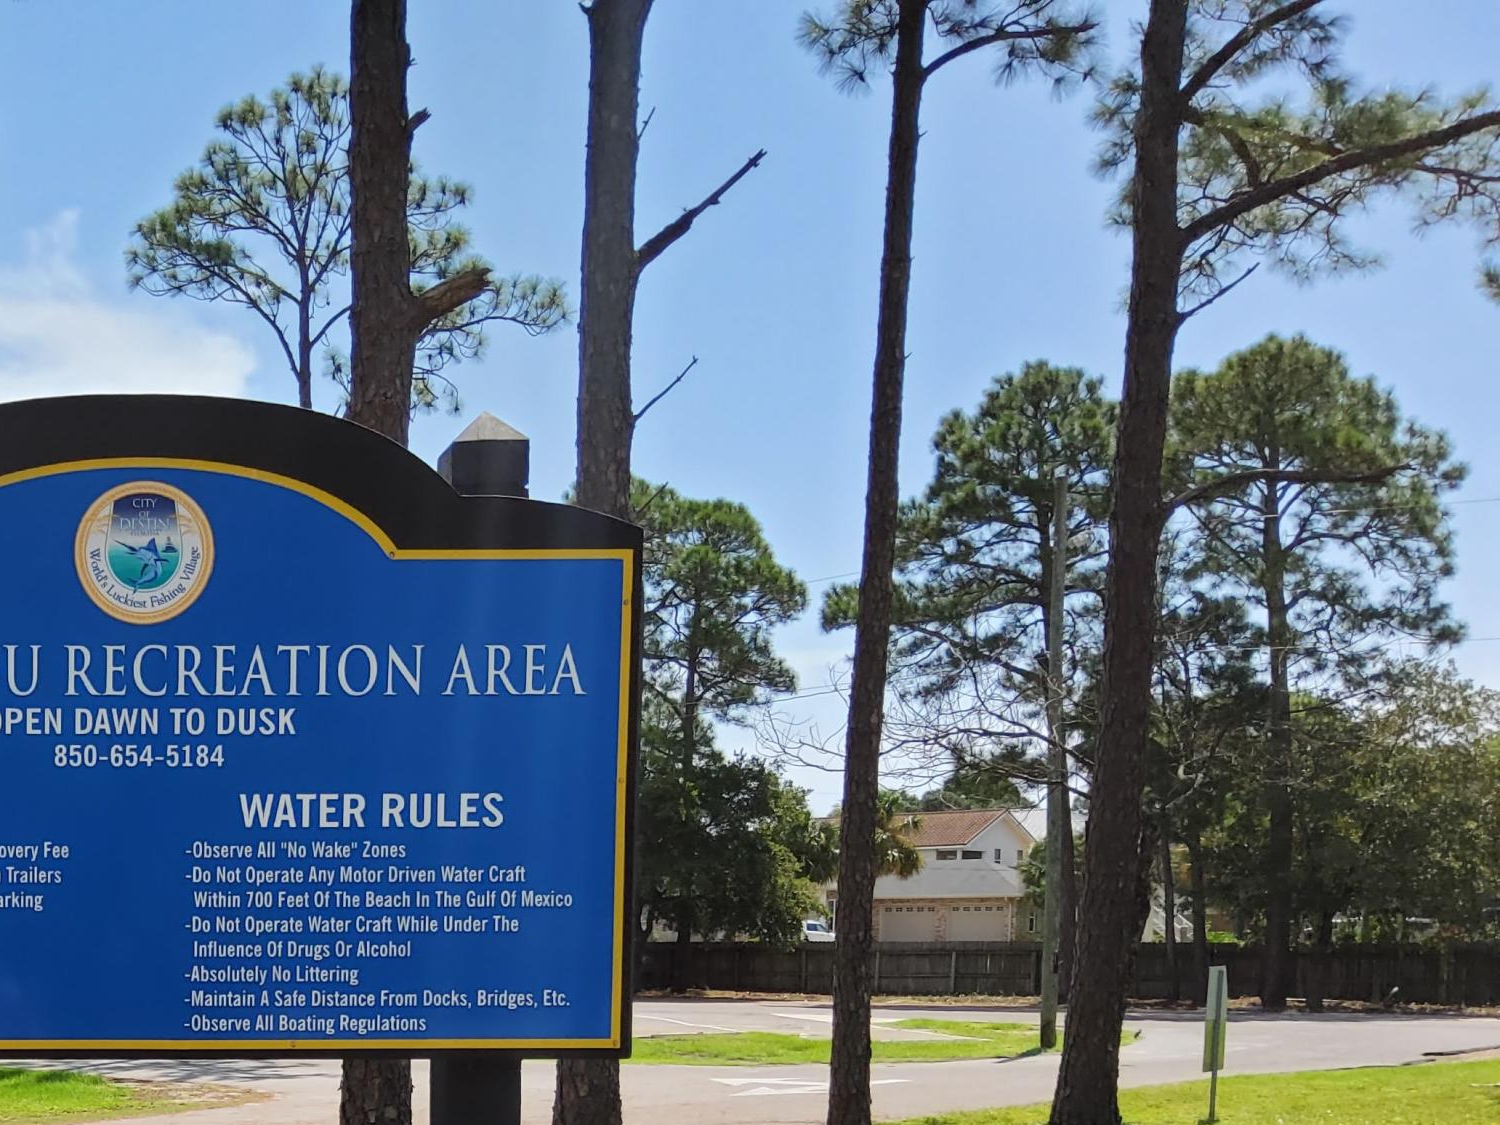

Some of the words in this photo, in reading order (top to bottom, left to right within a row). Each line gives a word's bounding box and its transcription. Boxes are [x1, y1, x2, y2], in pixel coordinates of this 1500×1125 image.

[132, 498, 158, 509] CITY
[119, 517, 170, 530] DESTIN
[89, 547, 108, 588] World's
[106, 584, 147, 608] Luckiest
[150, 583, 187, 608] Fishing
[180, 546, 201, 580] Village
[64, 643, 424, 697] RECREATION
[442, 643, 587, 697] AREA
[75, 708, 158, 734] DAWN
[170, 708, 205, 735] TO
[217, 708, 295, 735] DUSK
[54, 744, 224, 767] 850-654-5184
[240, 793, 365, 828] WATER
[382, 793, 503, 828] RULES
[44, 841, 69, 858] Fee
[186, 841, 252, 858] -Observe
[257, 841, 275, 858] All
[281, 841, 306, 858] "No
[312, 841, 357, 858] Wake"
[362, 841, 406, 858] Zones
[6, 866, 61, 883] Trailers
[185, 866, 211, 883] -Do
[217, 866, 241, 883] Not
[246, 866, 303, 886] Operate
[308, 866, 335, 886] Any
[340, 866, 384, 883] Motor
[388, 866, 435, 882] Driven
[441, 866, 484, 882] Water
[489, 865, 525, 882] Craft
[194, 891, 240, 908] Within
[246, 891, 272, 908] 700
[278, 891, 309, 908] Feet
[314, 891, 330, 908] Of
[334, 891, 360, 907] The
[366, 891, 410, 907] Beach
[416, 891, 429, 907] In
[435, 891, 461, 907] The
[466, 890, 496, 907] Gulf
[501, 890, 516, 907] Of
[521, 890, 572, 907] Mexico
[185, 916, 210, 932] -Do
[216, 916, 240, 932] Not
[245, 916, 303, 936] Operate
[308, 916, 351, 932] Water
[356, 915, 392, 932] Craft
[397, 916, 438, 932] While
[444, 916, 488, 932] Under
[493, 915, 519, 932] The
[194, 941, 262, 957] Influence
[267, 941, 283, 957] Of
[288, 941, 330, 961] Drugs
[335, 940, 353, 957] Or
[357, 941, 411, 957] Alcohol
[185, 965, 267, 985] -Absolutely
[272, 965, 291, 982] No
[296, 965, 359, 985] Littering
[184, 990, 255, 1007] -Maintain
[260, 990, 269, 1006] A
[274, 990, 306, 1006] Safe
[311, 990, 375, 1007] Distance
[381, 990, 417, 1006] From
[423, 990, 471, 1008] Docks,
[477, 990, 538, 1009] Bridges,
[543, 989, 570, 1006] Etc.
[184, 1014, 250, 1031] -Observe
[255, 1014, 273, 1031] All
[279, 1015, 335, 1035] Boating
[340, 1014, 426, 1035] Regulations
